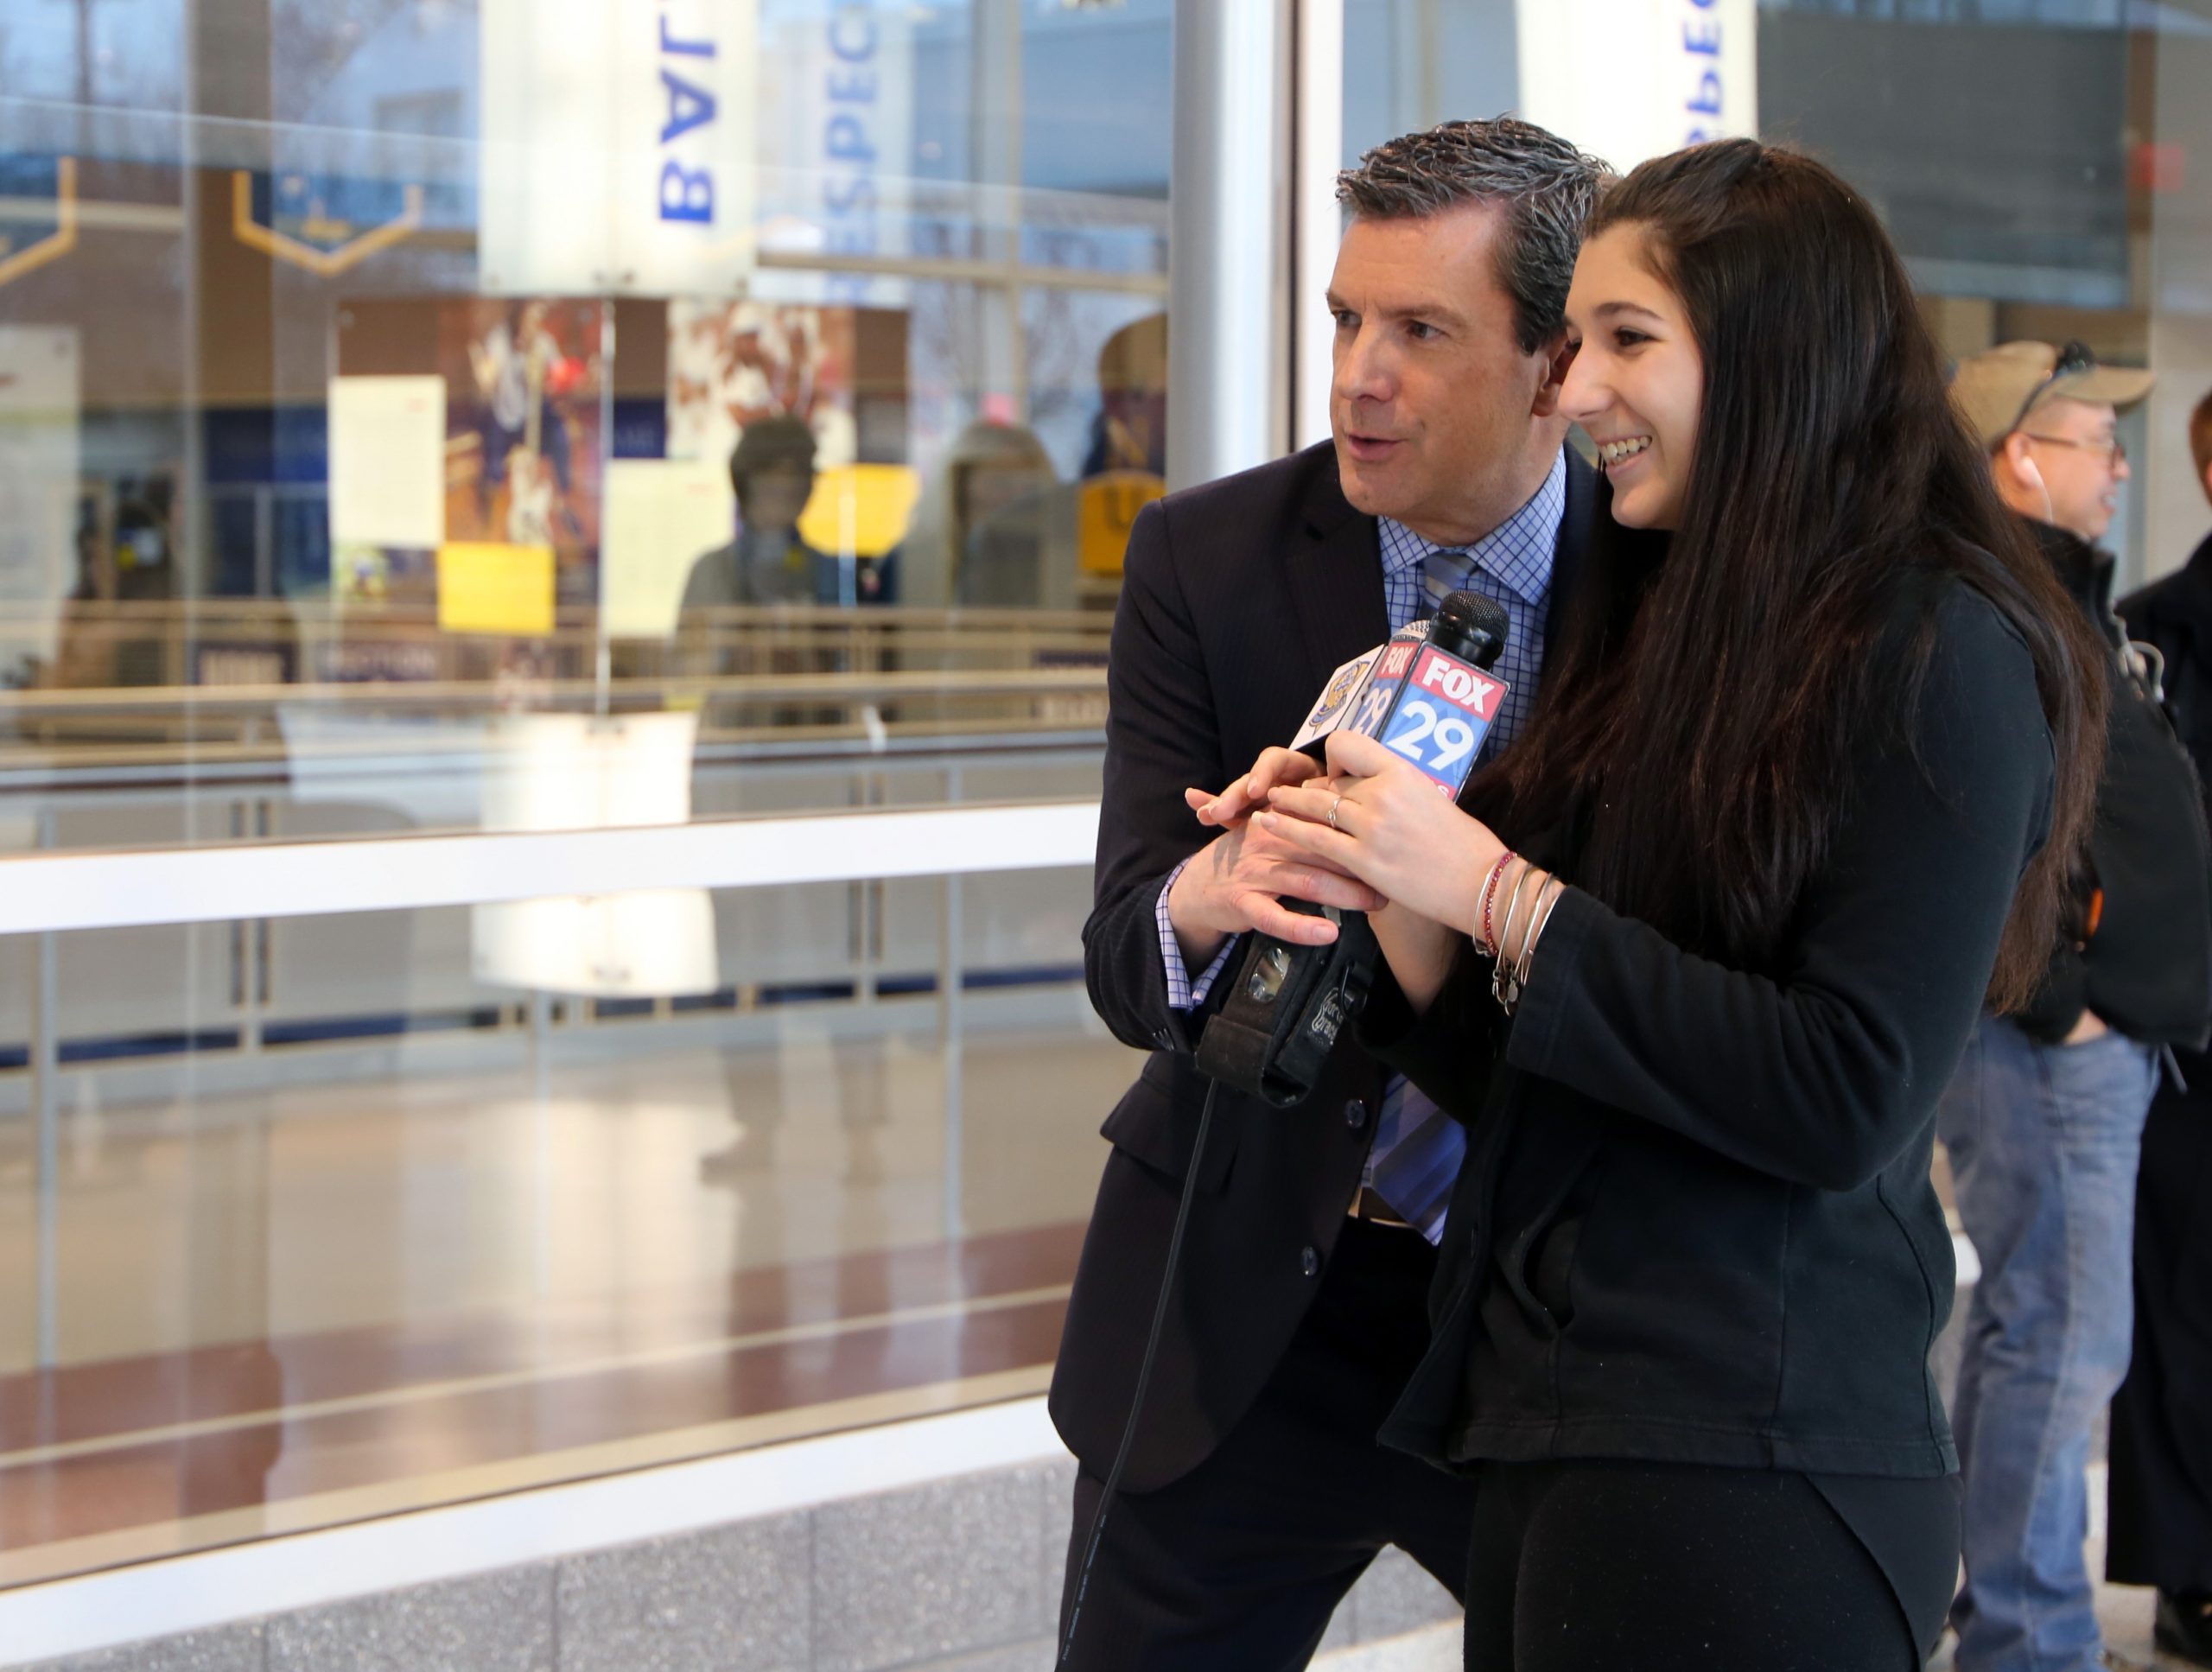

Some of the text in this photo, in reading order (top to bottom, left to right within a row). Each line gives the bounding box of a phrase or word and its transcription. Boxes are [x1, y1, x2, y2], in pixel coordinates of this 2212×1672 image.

[1381, 646, 1414, 675] FOX
[1423, 658, 1494, 714] FOX
[1387, 701, 1474, 771] 29
